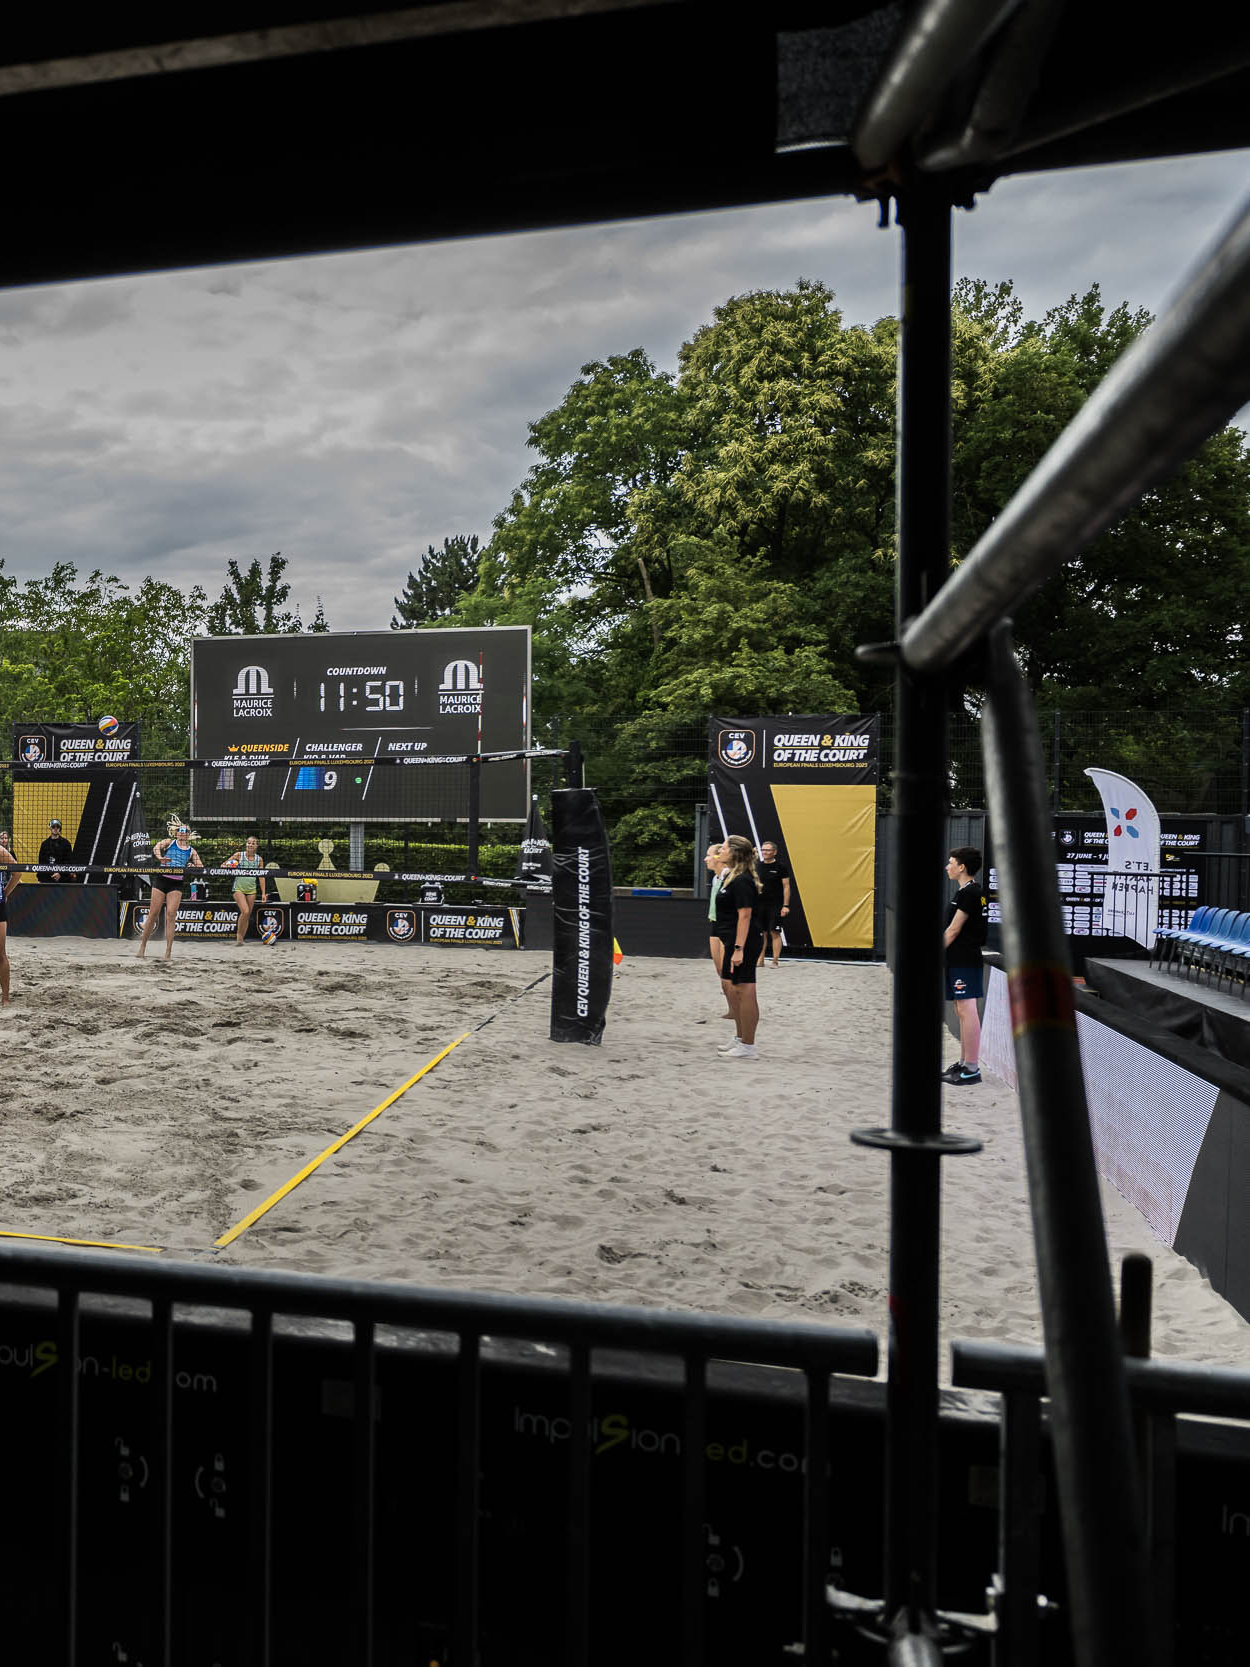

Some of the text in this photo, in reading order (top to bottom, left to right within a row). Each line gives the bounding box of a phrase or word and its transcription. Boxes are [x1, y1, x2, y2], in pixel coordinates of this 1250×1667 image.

[326, 666, 387, 676] COUNTDOWN
[319, 681, 405, 713] 11:50
[440, 695, 482, 704] MAURICE
[233, 699, 273, 709] MAURICE
[440, 705, 482, 714] LACROIX
[233, 708, 273, 718] LACROIX
[60, 738, 132, 750] QUEEN & KING
[773, 733, 871, 747] QUEEN & KING
[240, 743, 291, 754] QUEENSIDE
[305, 743, 364, 752] CHALLENGER
[387, 742, 428, 751] NEXT UP
[60, 752, 131, 762] OF THE COURT
[773, 749, 869, 762] OF THE COURT
[245, 771, 257, 791] 1
[323, 771, 338, 791] 9
[205, 910, 213, 921] &
[213, 909, 239, 921] KING
[297, 912, 368, 924] QUEEN & KING
[430, 915, 504, 927] QUEEN & KING
[184, 922, 204, 932] THE
[203, 922, 238, 933] COURT
[297, 925, 367, 935] OF THE COURT
[577, 846, 590, 1018] CEV QUEEN & KING OF THE COURT
[429, 928, 503, 939] OF THE COURT
